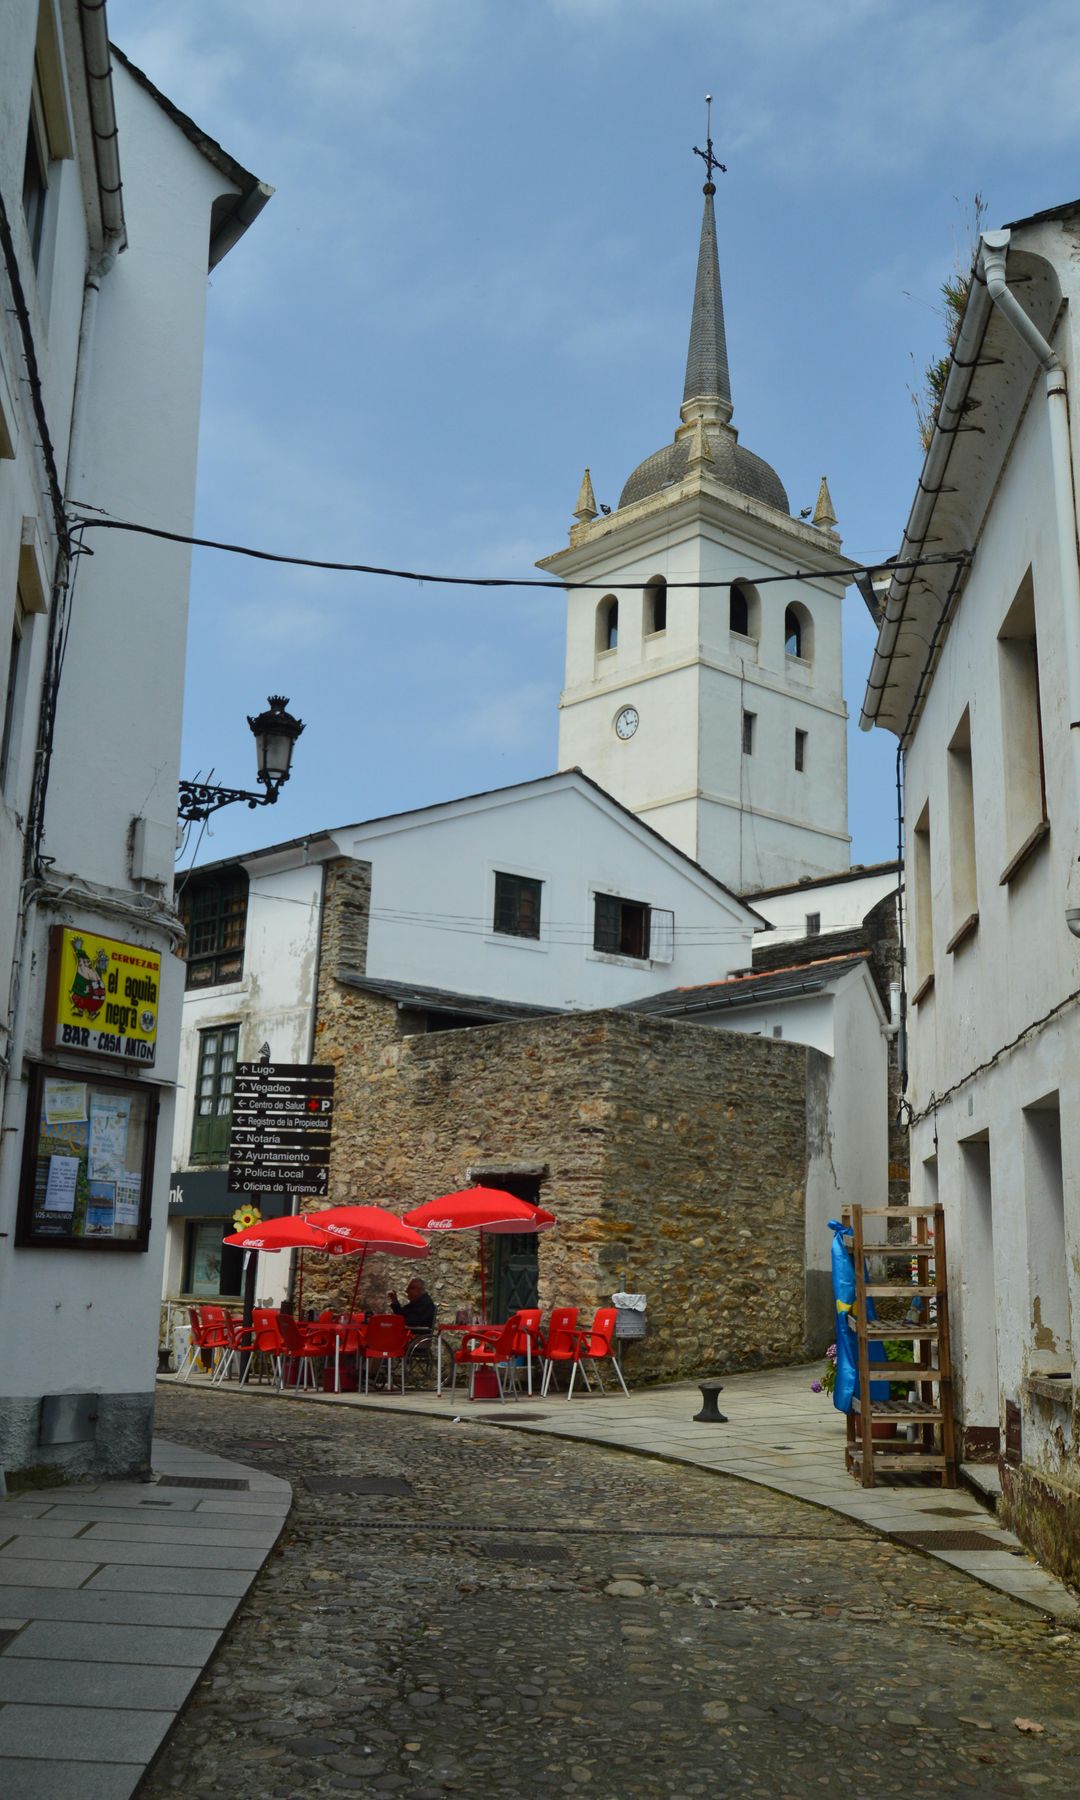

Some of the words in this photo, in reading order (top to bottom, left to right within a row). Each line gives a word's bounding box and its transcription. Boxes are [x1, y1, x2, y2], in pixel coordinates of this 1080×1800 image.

[111, 952, 159, 971] CERVEZAS
[108, 968, 119, 995] el
[124, 975, 157, 1006] aguila
[105, 1002, 137, 1034] negra
[62, 1023, 90, 1047] BAR
[97, 1032, 121, 1054] CASA
[251, 1065, 275, 1077] Lugo
[250, 1082, 291, 1094] Vegadeo
[249, 1100, 273, 1109] Centro
[274, 1101, 284, 1110] de
[285, 1101, 305, 1110] Salud
[321, 1100, 331, 1111] P
[248, 1117, 275, 1128] Registro
[276, 1118, 286, 1127] de
[287, 1118, 293, 1127] la
[294, 1118, 328, 1130] Propiedad
[246, 1134, 281, 1144] Notaría
[245, 1151, 310, 1162] Ayuntamiento
[244, 1168, 276, 1178] Policía
[278, 1169, 304, 1179] Local
[243, 1181, 271, 1192] Oficina
[273, 1182, 284, 1192] de
[286, 1183, 317, 1193] Turismo
